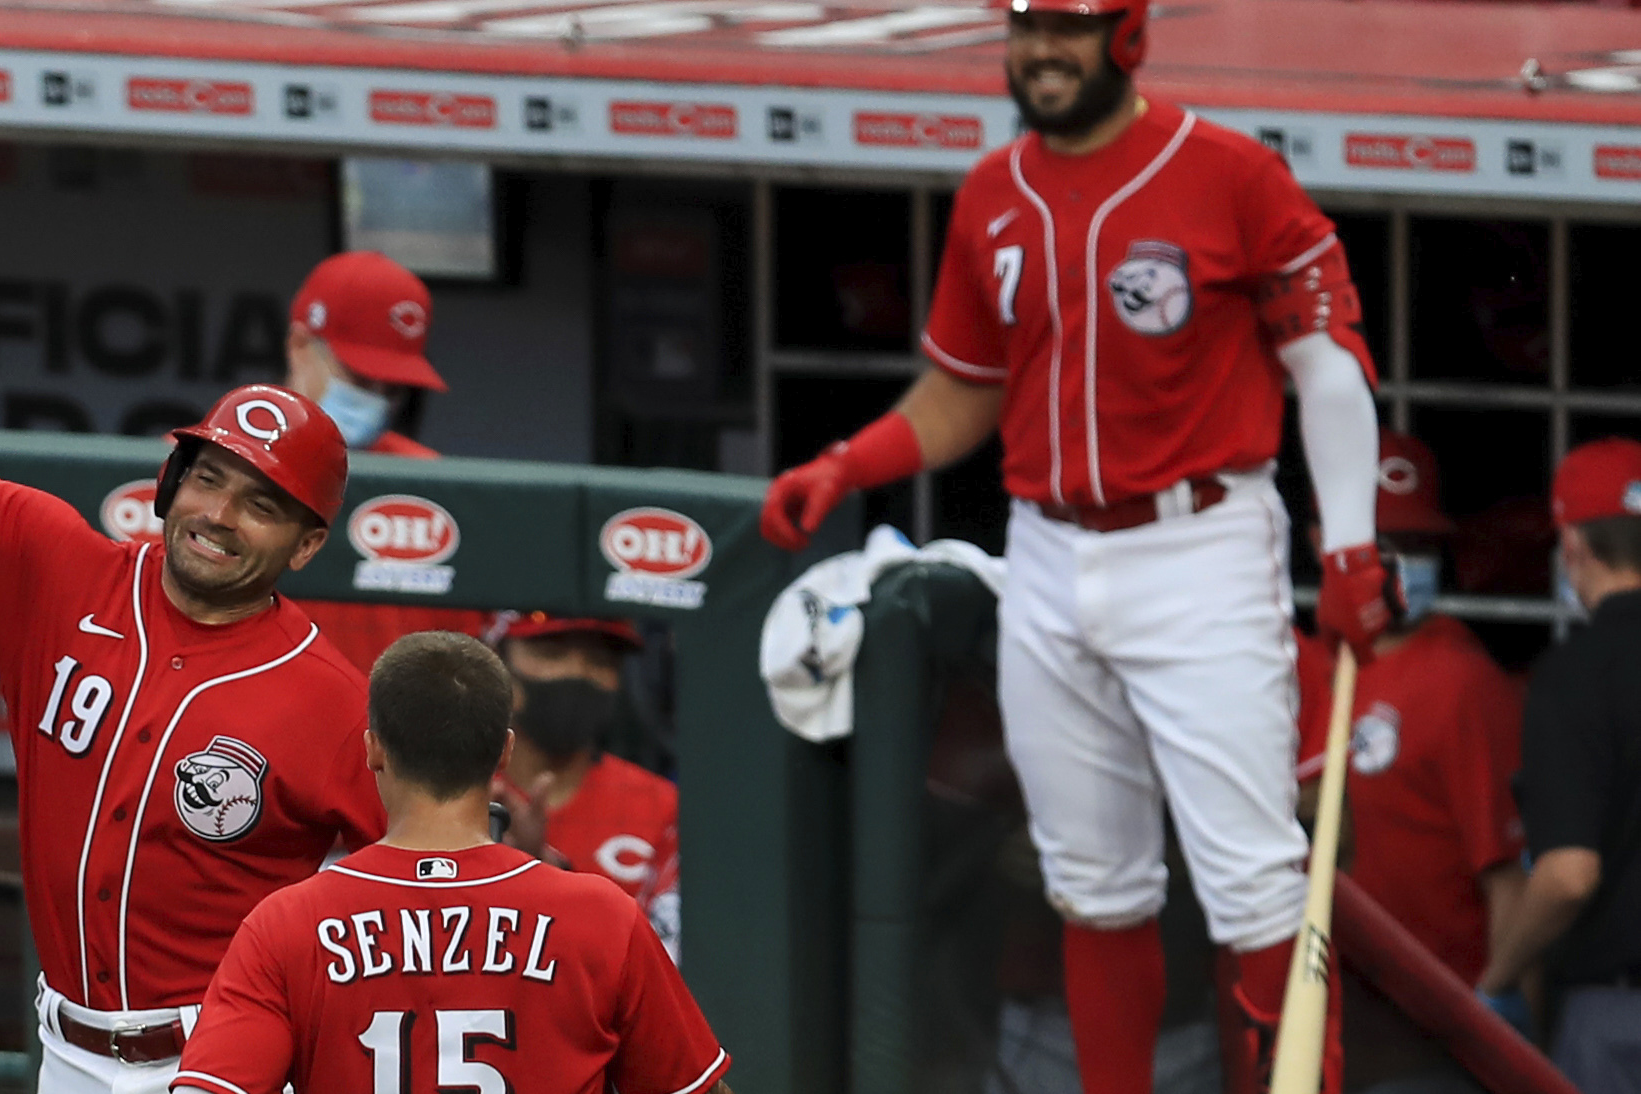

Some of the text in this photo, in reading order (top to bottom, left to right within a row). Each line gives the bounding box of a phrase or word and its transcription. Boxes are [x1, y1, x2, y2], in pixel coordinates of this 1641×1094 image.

[994, 245, 1024, 325] 7
[236, 399, 286, 440] C
[38, 655, 114, 757] 19
[317, 906, 557, 984] SENZEL
